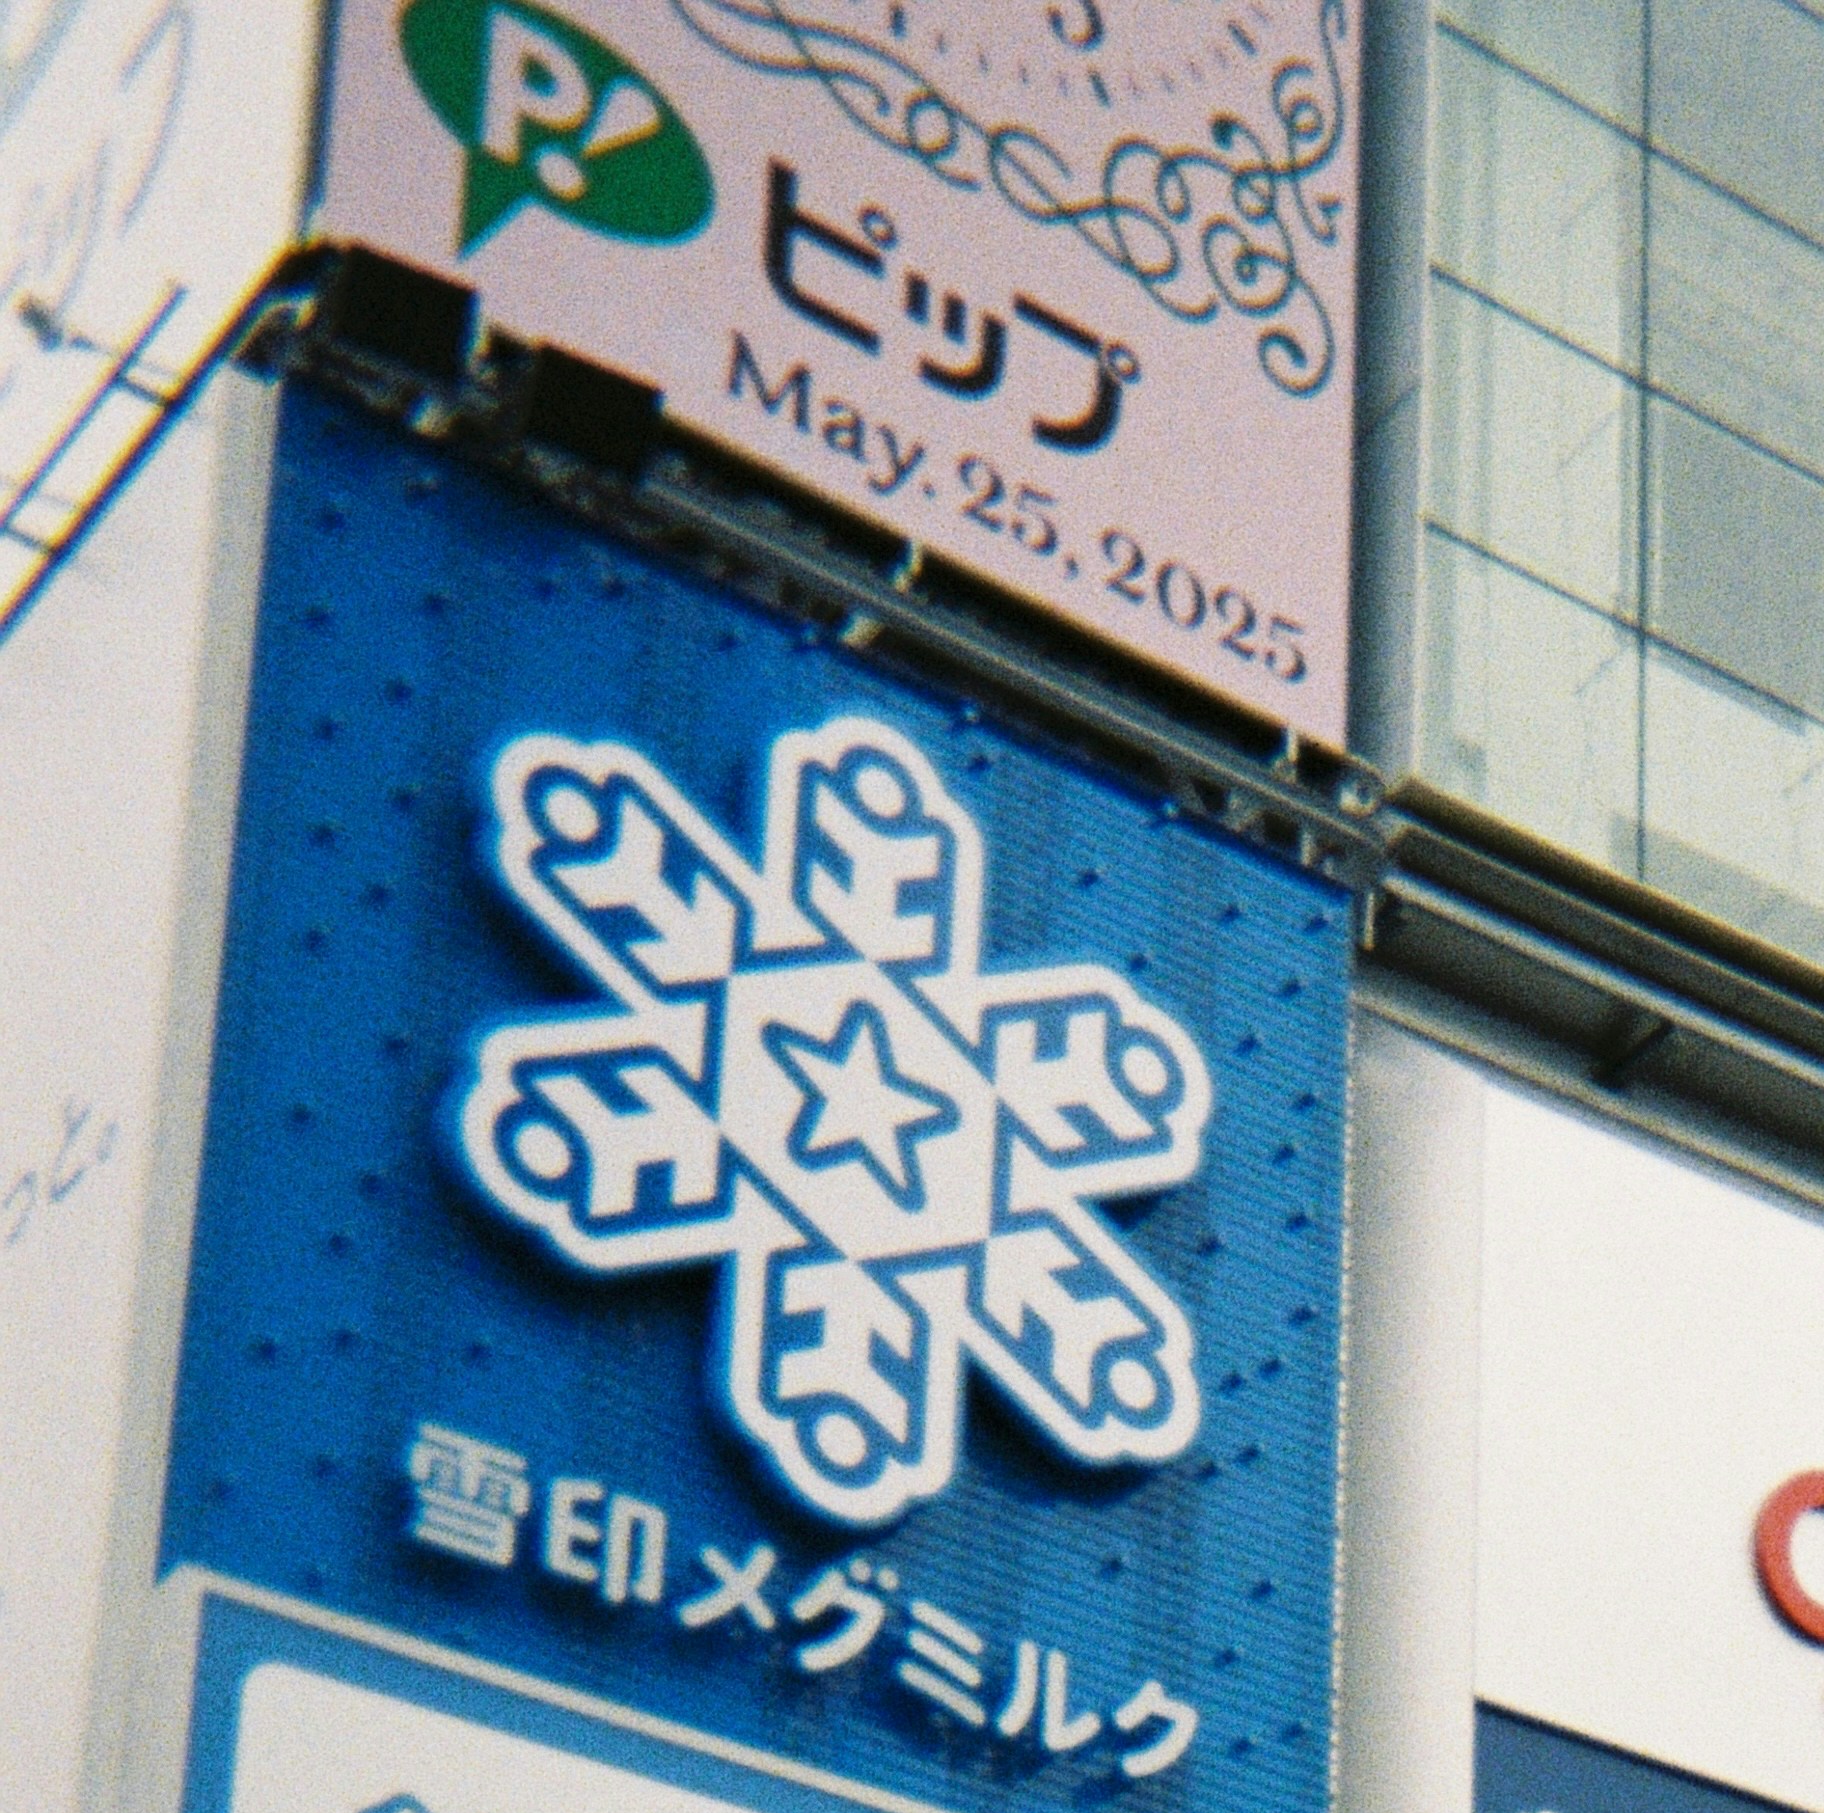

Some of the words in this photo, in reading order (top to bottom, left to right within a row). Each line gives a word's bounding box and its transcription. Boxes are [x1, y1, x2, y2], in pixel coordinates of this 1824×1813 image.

[764, 155, 1142, 452] ピップ
[727, 329, 937, 499] May.
[956, 450, 1081, 580] 25,
[1099, 526, 1308, 684] 2025
[407, 1418, 1202, 1780] 雪印メグミルク
